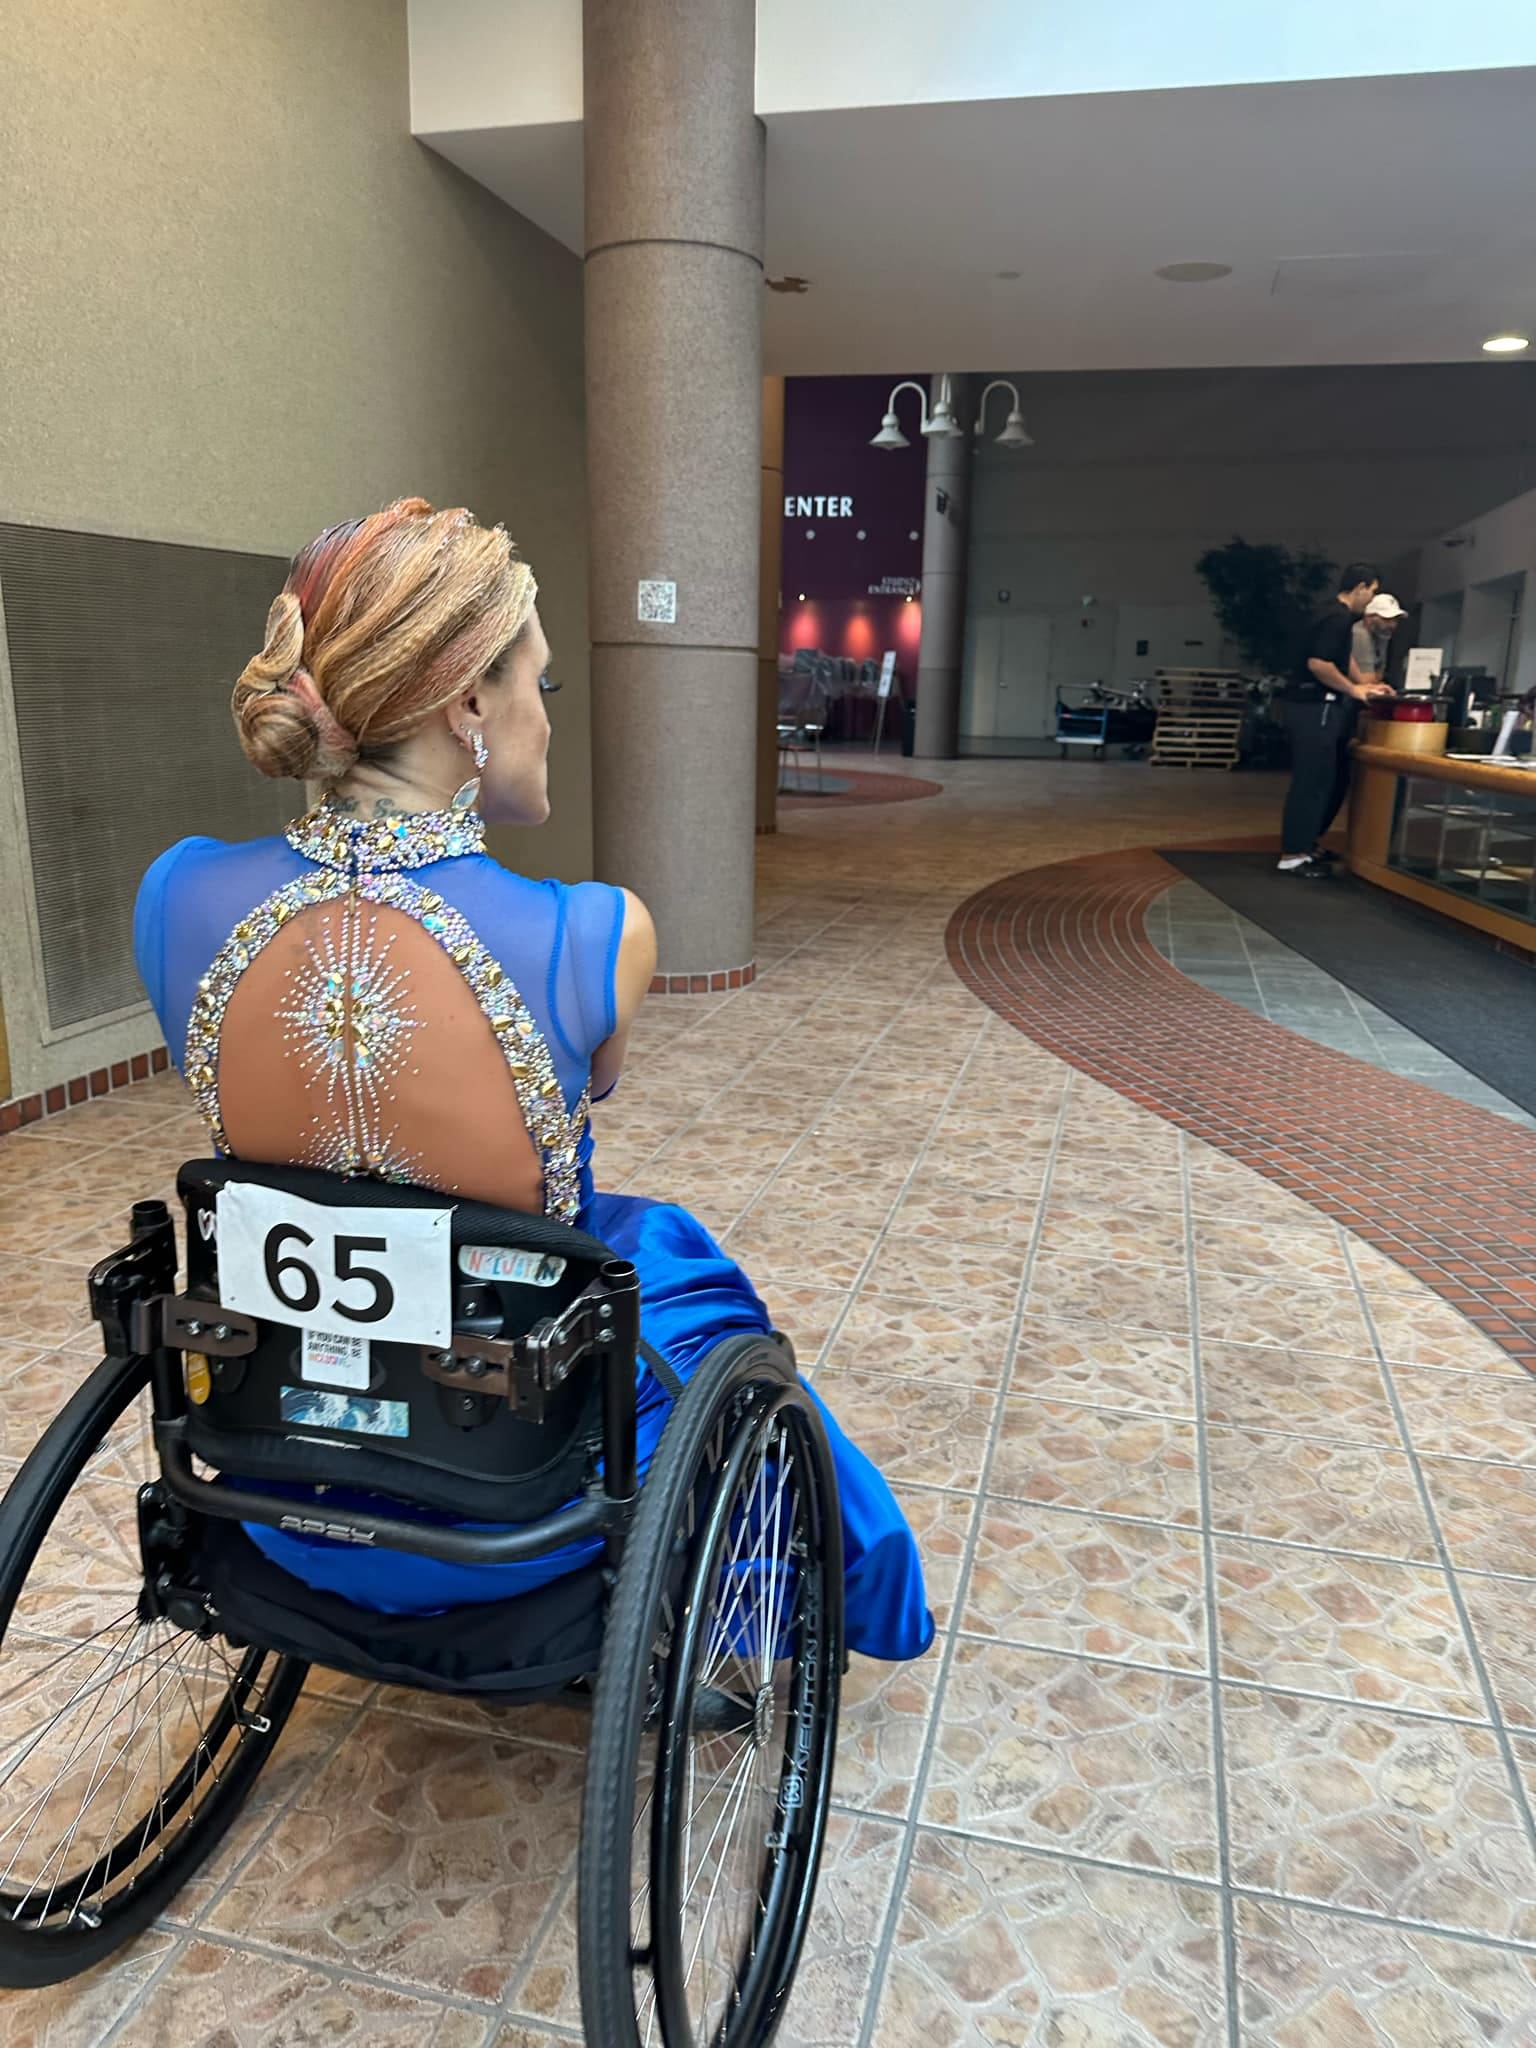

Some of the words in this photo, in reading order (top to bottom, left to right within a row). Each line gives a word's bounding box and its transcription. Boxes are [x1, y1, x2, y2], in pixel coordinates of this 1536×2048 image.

[784, 496, 853, 517] ENTER
[264, 1223, 394, 1323] 65
[796, 1639, 818, 1774] NEWTON
